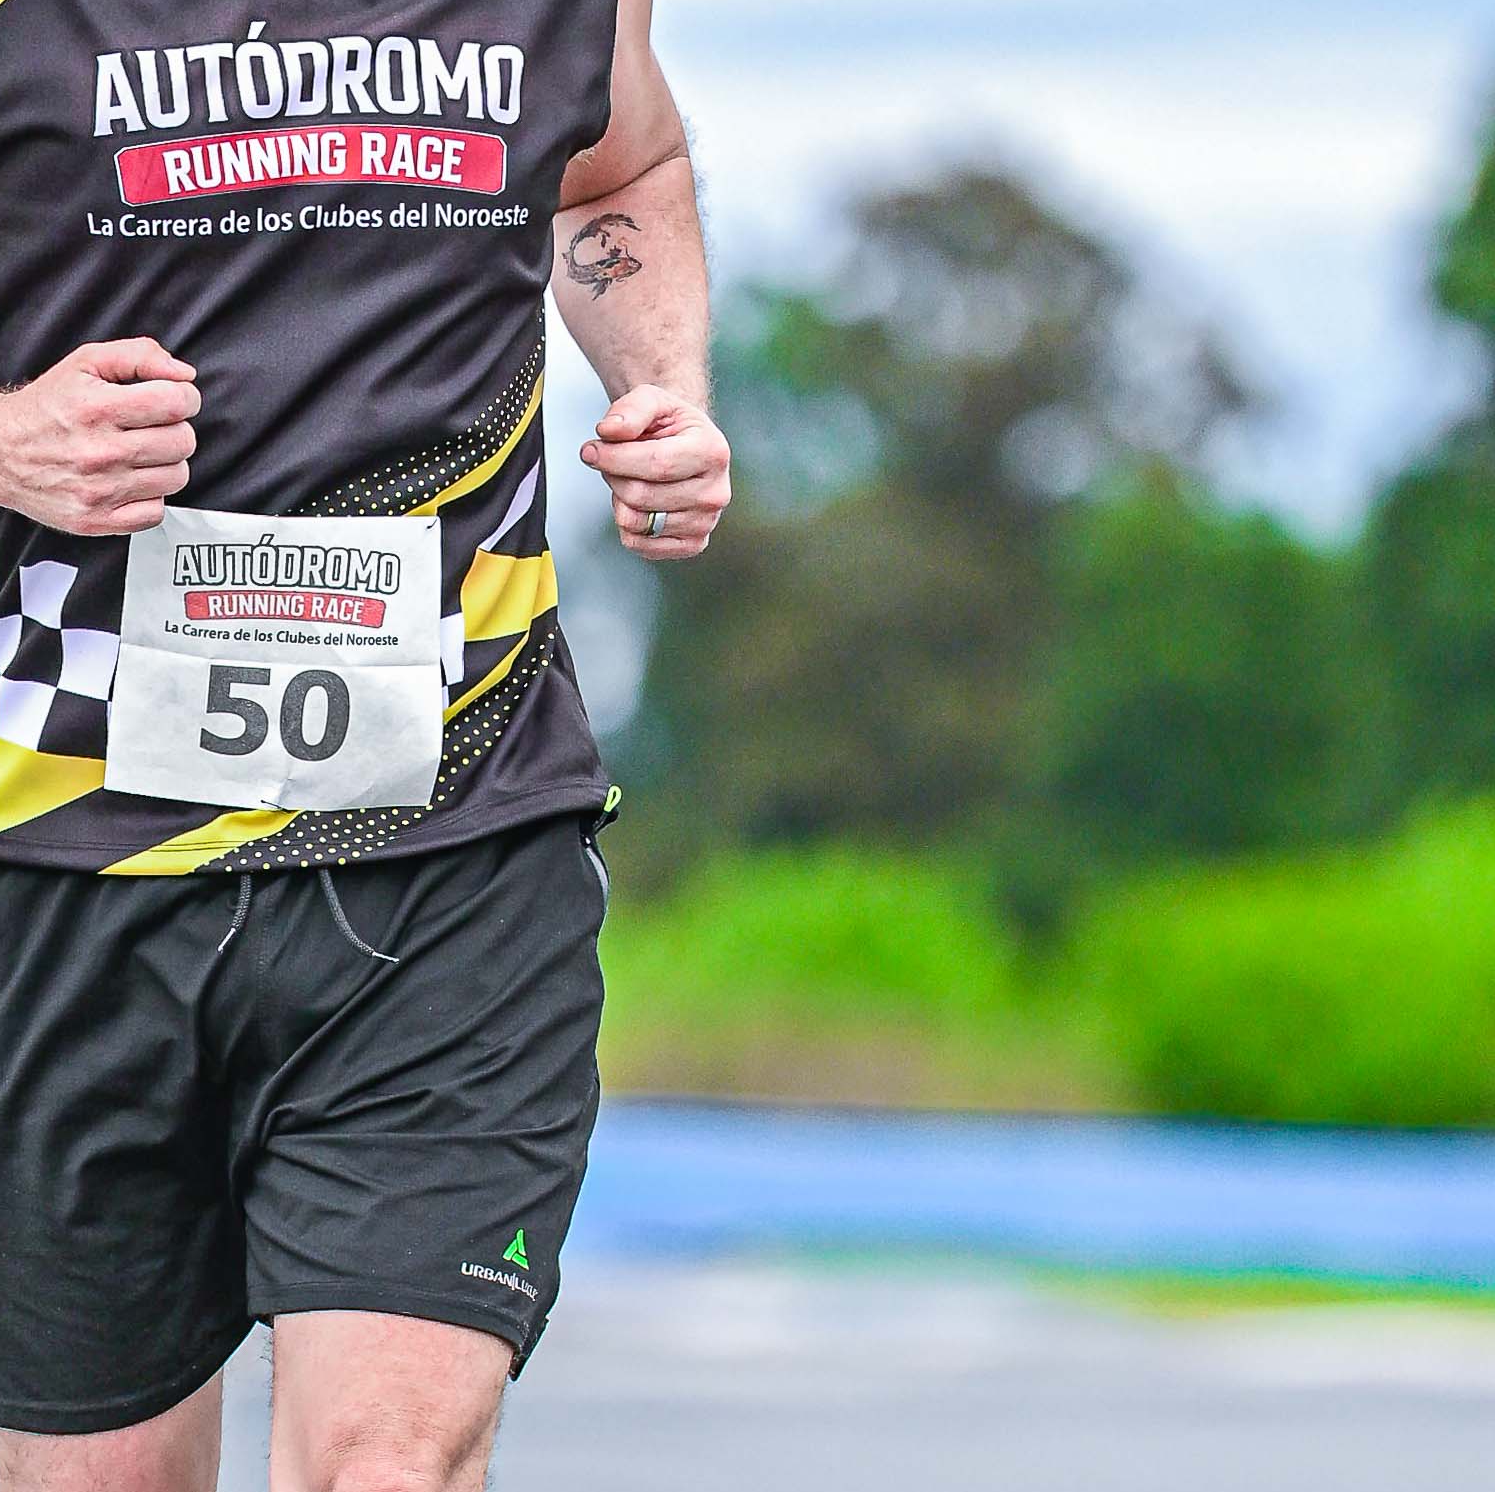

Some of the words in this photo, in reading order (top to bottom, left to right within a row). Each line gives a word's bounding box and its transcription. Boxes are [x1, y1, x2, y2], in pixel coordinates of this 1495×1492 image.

[93, 21, 526, 137] AUTÓDROMO
[162, 131, 347, 195] RUNNING
[361, 131, 466, 184] RACE
[87, 212, 114, 237] La
[119, 213, 212, 237] Carrera
[220, 209, 251, 235] de
[256, 207, 292, 232] los
[299, 203, 384, 230] Clubes
[389, 203, 427, 228] del
[435, 202, 529, 228] Noroeste
[173, 534, 400, 595] AUTÓDROMO
[164, 620, 179, 634] La
[182, 624, 231, 640] Carrera
[233, 628, 251, 641] de
[254, 629, 273, 642] los
[276, 630, 321, 645] Clubes
[323, 632, 343, 646] del
[346, 633, 399, 646] Noroeste
[207, 593, 305, 618] RUNNING
[310, 596, 365, 623] RACE
[200, 664, 350, 762] 50
